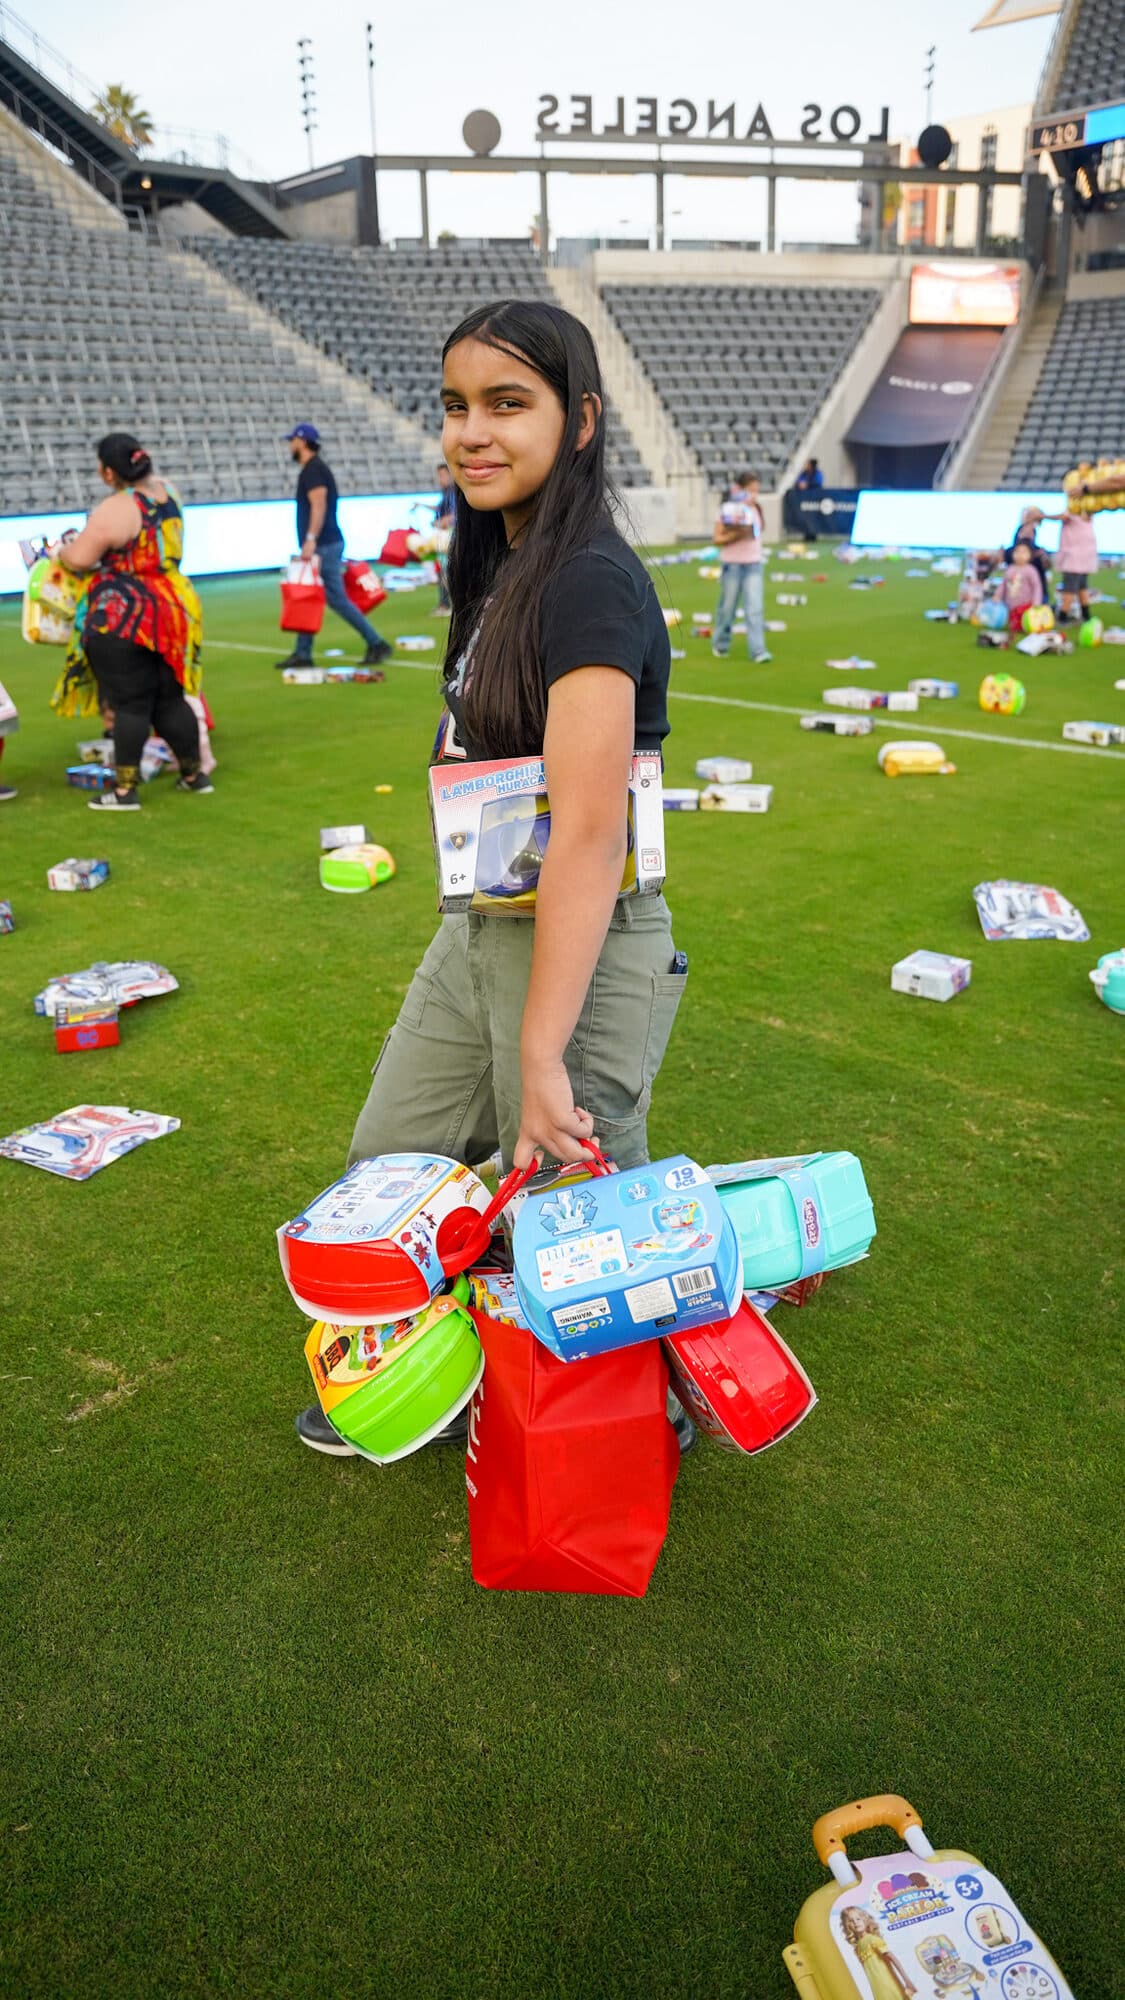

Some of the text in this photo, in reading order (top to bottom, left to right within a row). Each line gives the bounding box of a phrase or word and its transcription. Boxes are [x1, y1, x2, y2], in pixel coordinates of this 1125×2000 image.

[497, 774, 546, 794] HURACA
[450, 873, 467, 885] 6+
[671, 1167, 694, 1183] 19
[676, 1177, 697, 1189] PCS
[560, 1311, 594, 1325] WARNING
[325, 1342, 341, 1372] BBQ
[902, 1890, 934, 1902] CREAM
[957, 1881, 979, 1897] 3+
[886, 1898, 947, 1923] PARLOR
